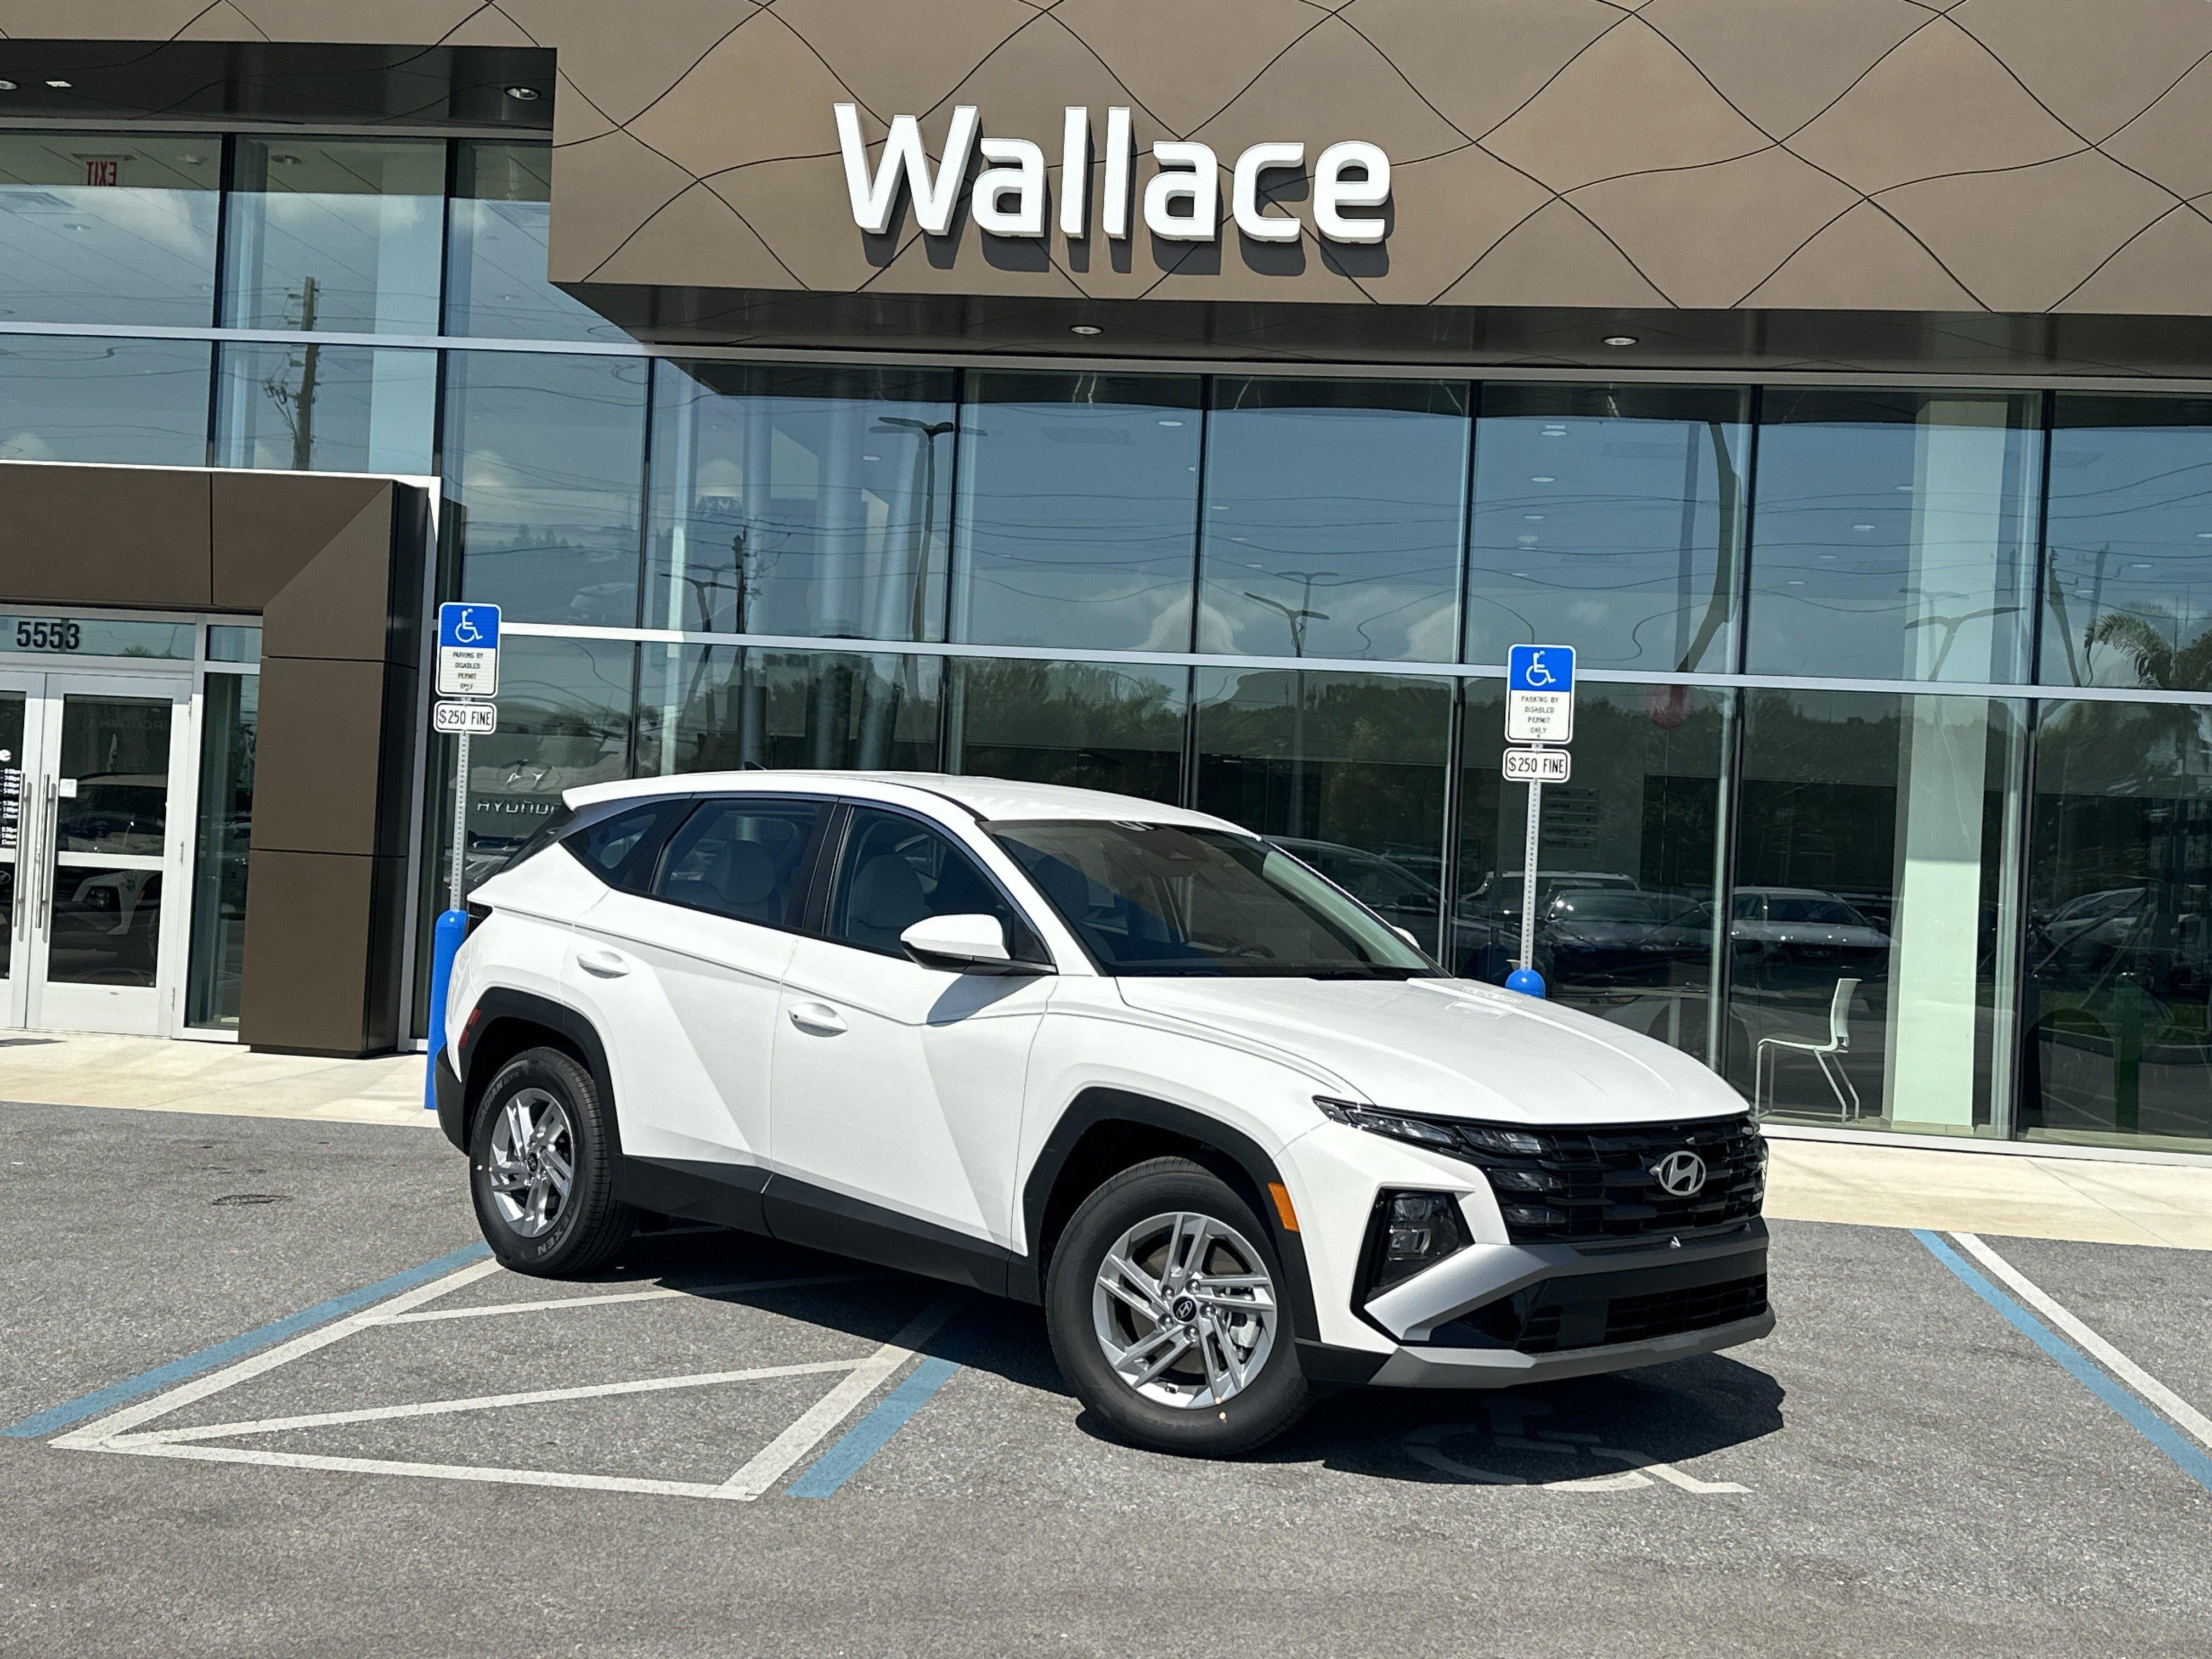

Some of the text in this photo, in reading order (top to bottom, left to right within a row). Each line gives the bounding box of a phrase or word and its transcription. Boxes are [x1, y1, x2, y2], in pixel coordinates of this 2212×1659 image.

[834, 103, 1391, 244] Wallace
[16, 621, 80, 650] 5553
[439, 708, 492, 725] $250 FINE
[1508, 756, 1565, 774] $250 FINE
[476, 798, 562, 815] HYUND
[537, 1201, 576, 1256] NEXEN
